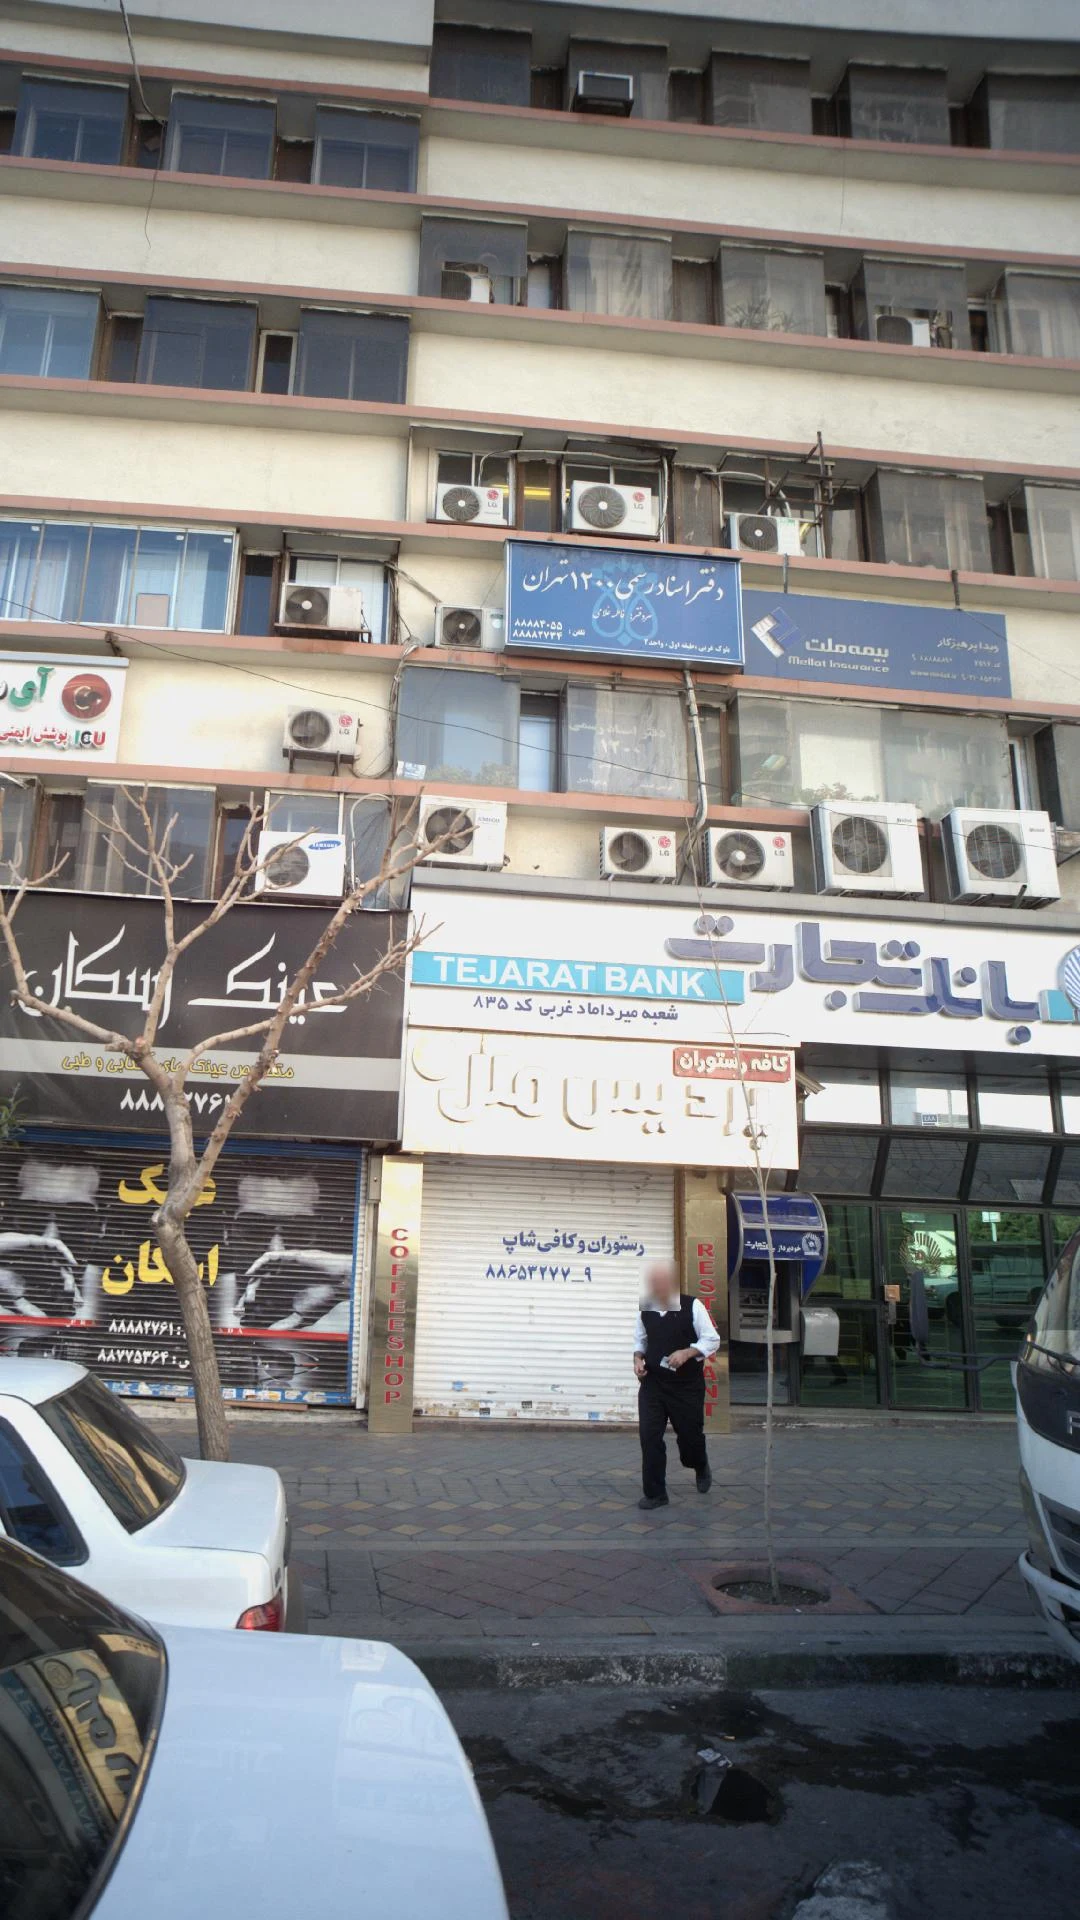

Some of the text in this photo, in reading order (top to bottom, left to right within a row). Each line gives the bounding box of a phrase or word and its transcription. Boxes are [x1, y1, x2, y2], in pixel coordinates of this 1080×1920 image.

[522, 559, 724, 606] دفتر اسناد رسمی ۱۲۰۰ تهران
[805, 637, 889, 663] بیمه ملت
[936, 637, 978, 653] پرهیزکار
[787, 654, 890, 674] Mellat Insurance
[33, 727, 68, 746] پوشش
[74, 730, 107, 745] ICU
[187, 931, 348, 1026] عینک
[433, 954, 706, 999] TEJARAT BANK
[663, 913, 1041, 1046] بانک تجارت
[473, 995, 679, 1026] شعبه میرداماد غربی کد ۸۳۵
[62, 1051, 92, 1071] طبی
[96, 1057, 104, 1072] و
[188, 1058, 228, 1076] عینک
[679, 1050, 790, 1074] کافه رستوران
[502, 1228, 645, 1257] رستوران و کافی شاپ
[102, 1240, 219, 1296] اکان
[108, 1318, 174, 1336] ۸۸۸۸۲۷۶۱
[383, 1227, 410, 1405] COFFEE SHOP
[696, 1242, 719, 1418] RESTANT
[97, 1348, 170, 1366] ۸۸۷۷۵۳۶۴
